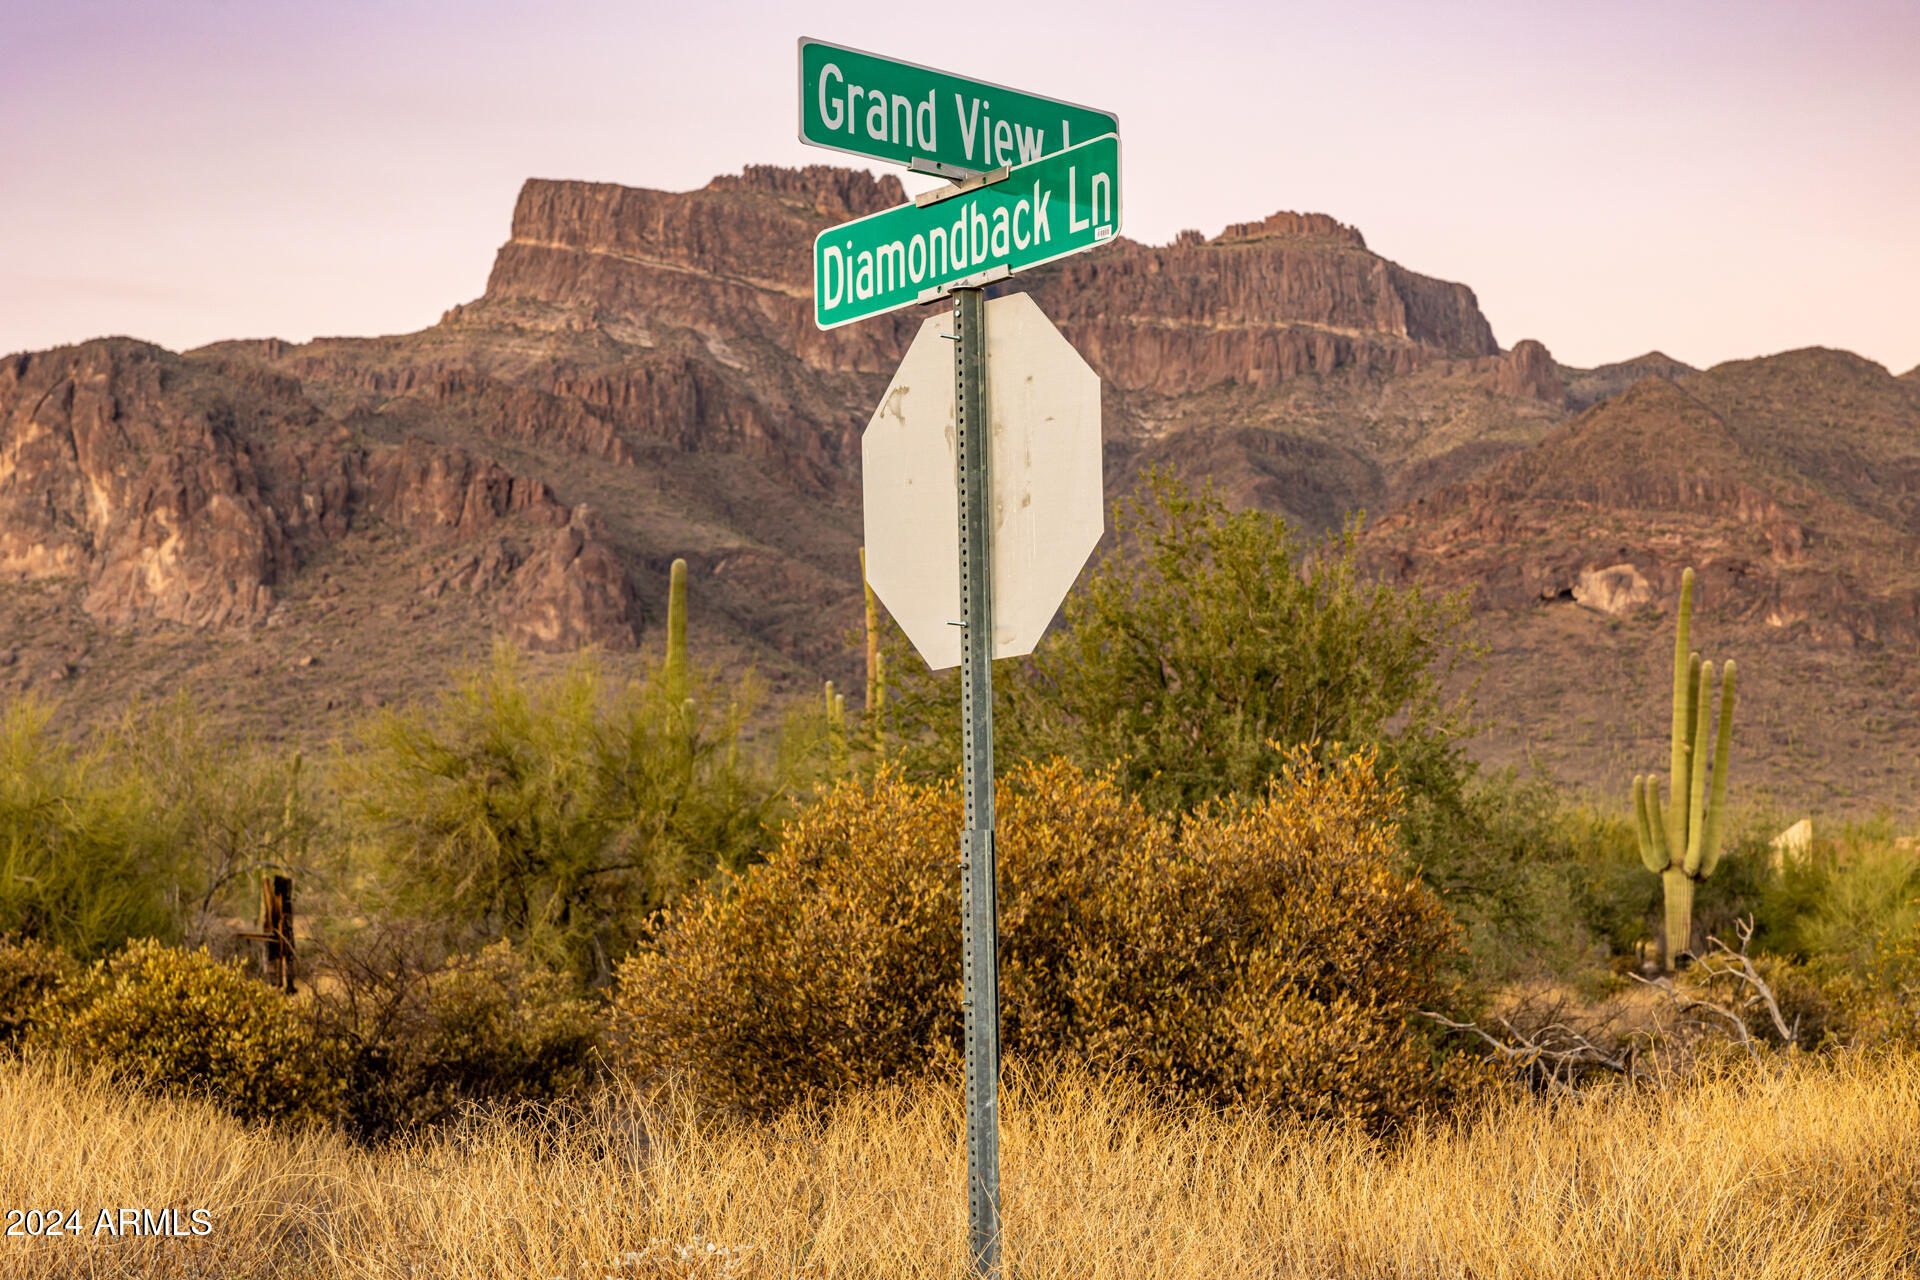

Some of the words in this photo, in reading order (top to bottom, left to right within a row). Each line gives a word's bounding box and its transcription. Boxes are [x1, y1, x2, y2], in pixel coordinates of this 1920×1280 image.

[818, 63, 937, 153] Grand
[955, 93, 1044, 166] View
[823, 179, 1051, 310] Diamondback
[1069, 166, 1111, 234] Ln
